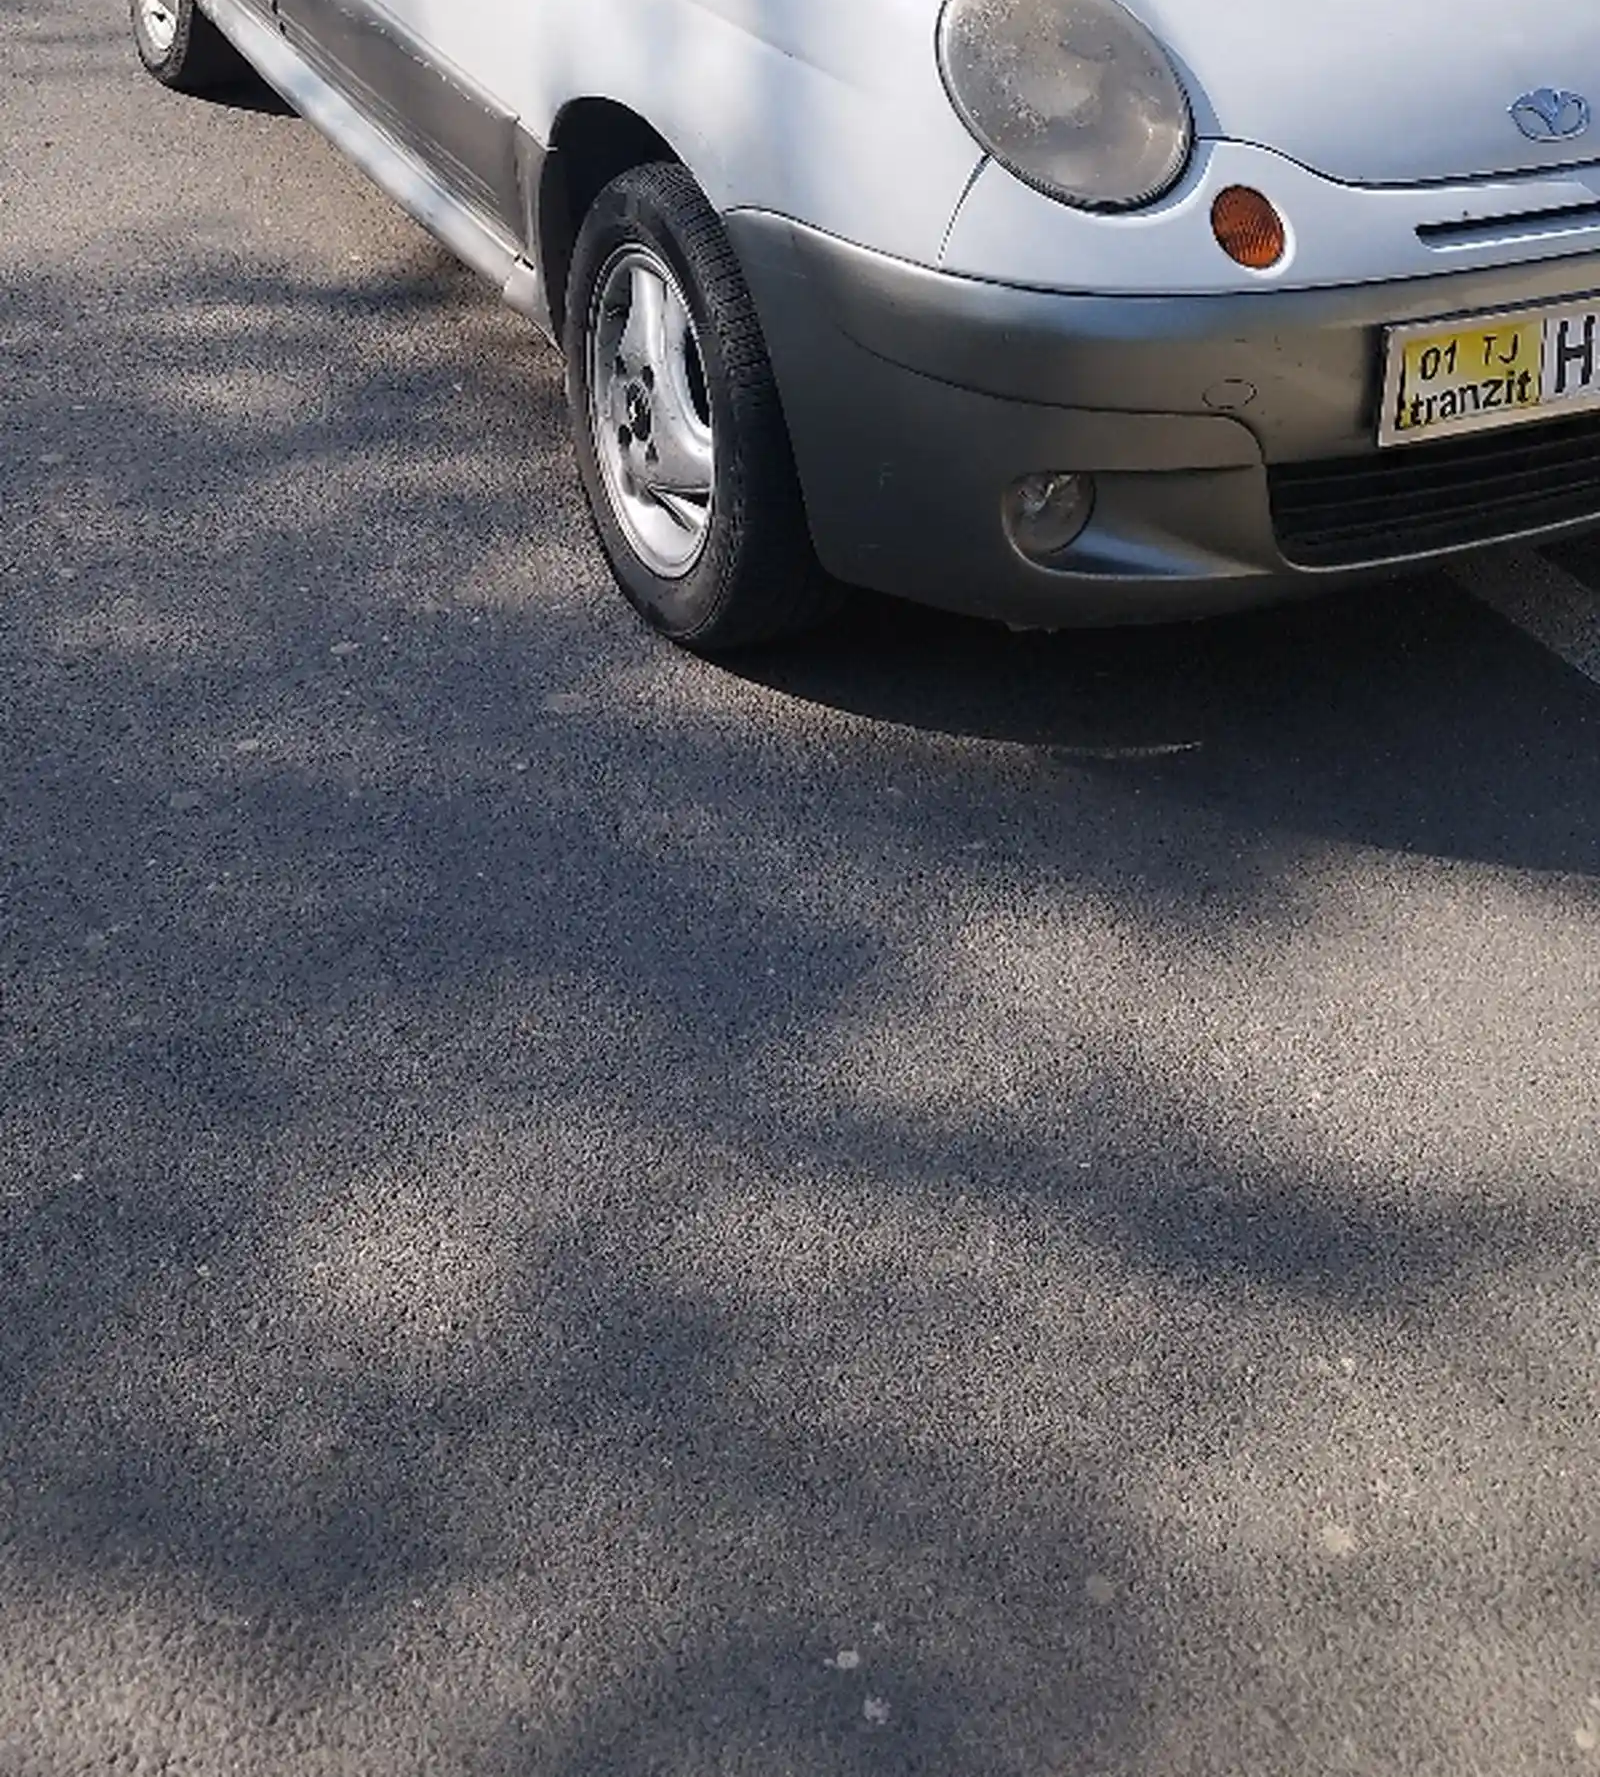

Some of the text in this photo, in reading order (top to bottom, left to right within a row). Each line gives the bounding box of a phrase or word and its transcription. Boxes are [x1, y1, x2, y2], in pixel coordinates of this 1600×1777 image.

[1420, 332, 1519, 380] 01 TJ
[1553, 314, 1597, 393] H
[1408, 367, 1533, 425] tranzit
